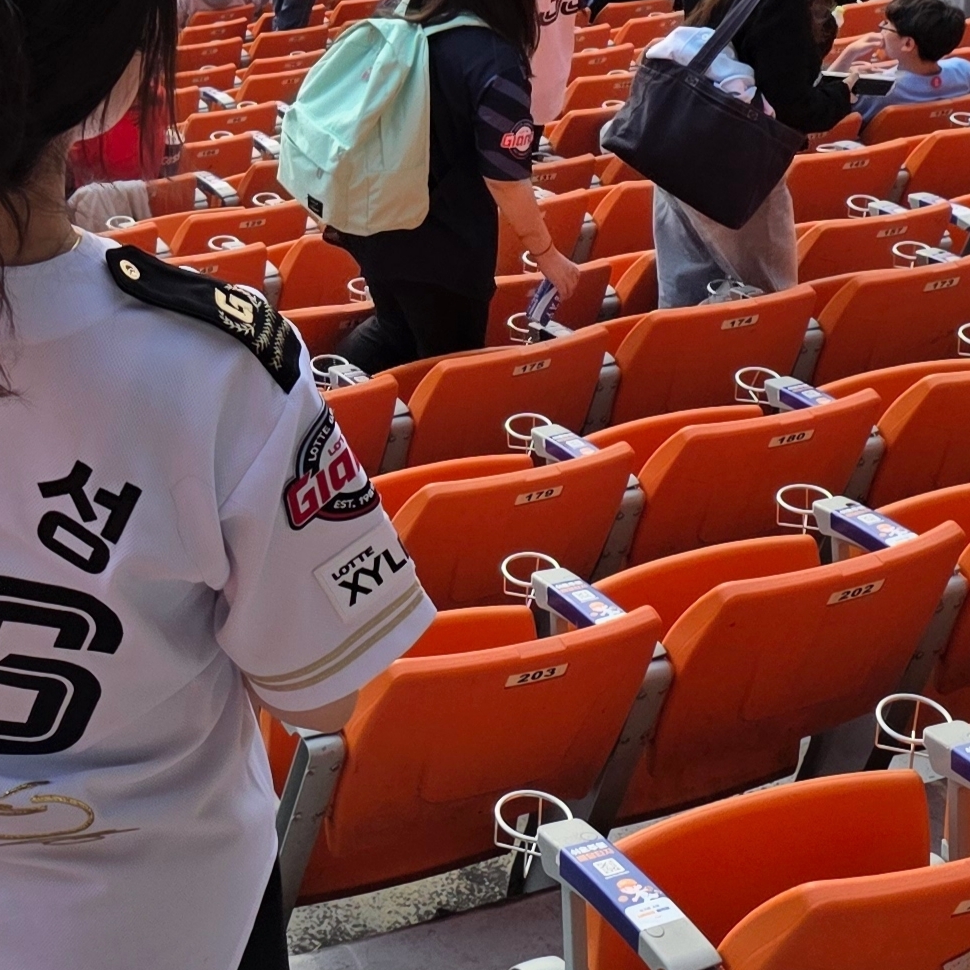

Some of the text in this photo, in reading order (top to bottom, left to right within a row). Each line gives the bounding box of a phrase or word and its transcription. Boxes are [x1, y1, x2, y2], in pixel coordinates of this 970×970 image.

[932, 279, 954, 290] 173
[729, 317, 753, 328] 174
[521, 361, 545, 373] 175
[308, 424, 331, 462] LOTTE
[327, 434, 344, 457] LOT
[778, 432, 806, 444] 180
[333, 482, 374, 510] EST. 198
[525, 489, 554, 502] 179
[331, 546, 375, 581] LOTTE
[838, 584, 875, 601] 202
[517, 668, 557, 683] 203
